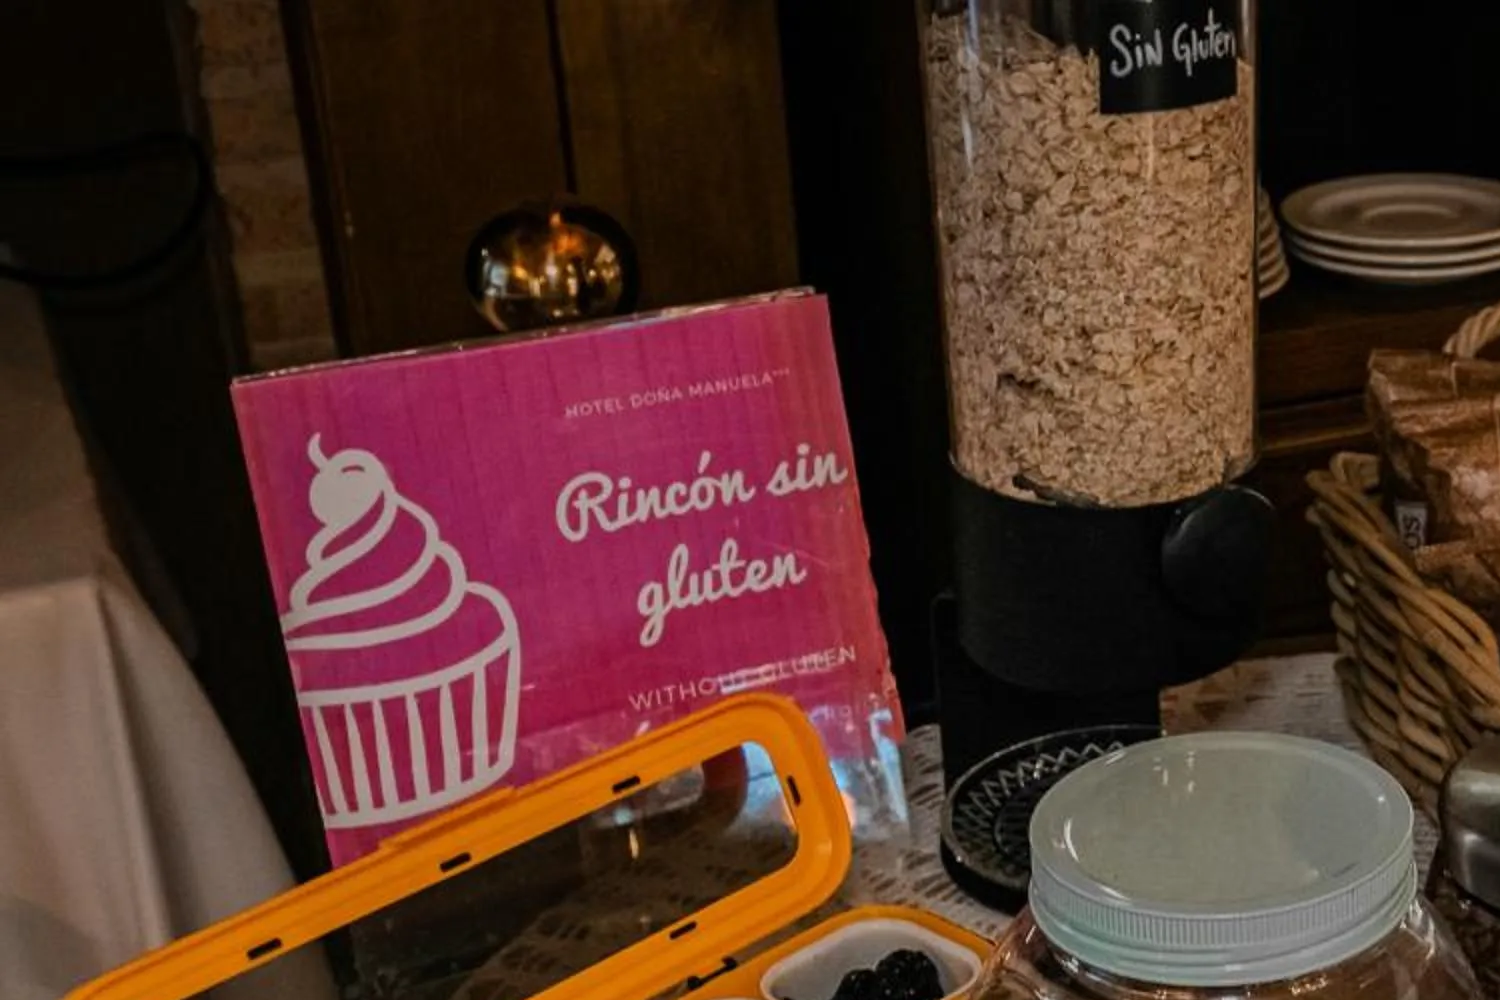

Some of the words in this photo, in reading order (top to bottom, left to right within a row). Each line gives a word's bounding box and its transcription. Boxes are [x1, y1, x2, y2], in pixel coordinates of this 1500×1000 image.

[1172, 7, 1237, 77] Gluten
[565, 398, 625, 419] HOTEL
[630, 384, 684, 409] DOÑA
[556, 451, 756, 542] Rincón
[766, 444, 848, 497] sin
[637, 538, 807, 647] gluten
